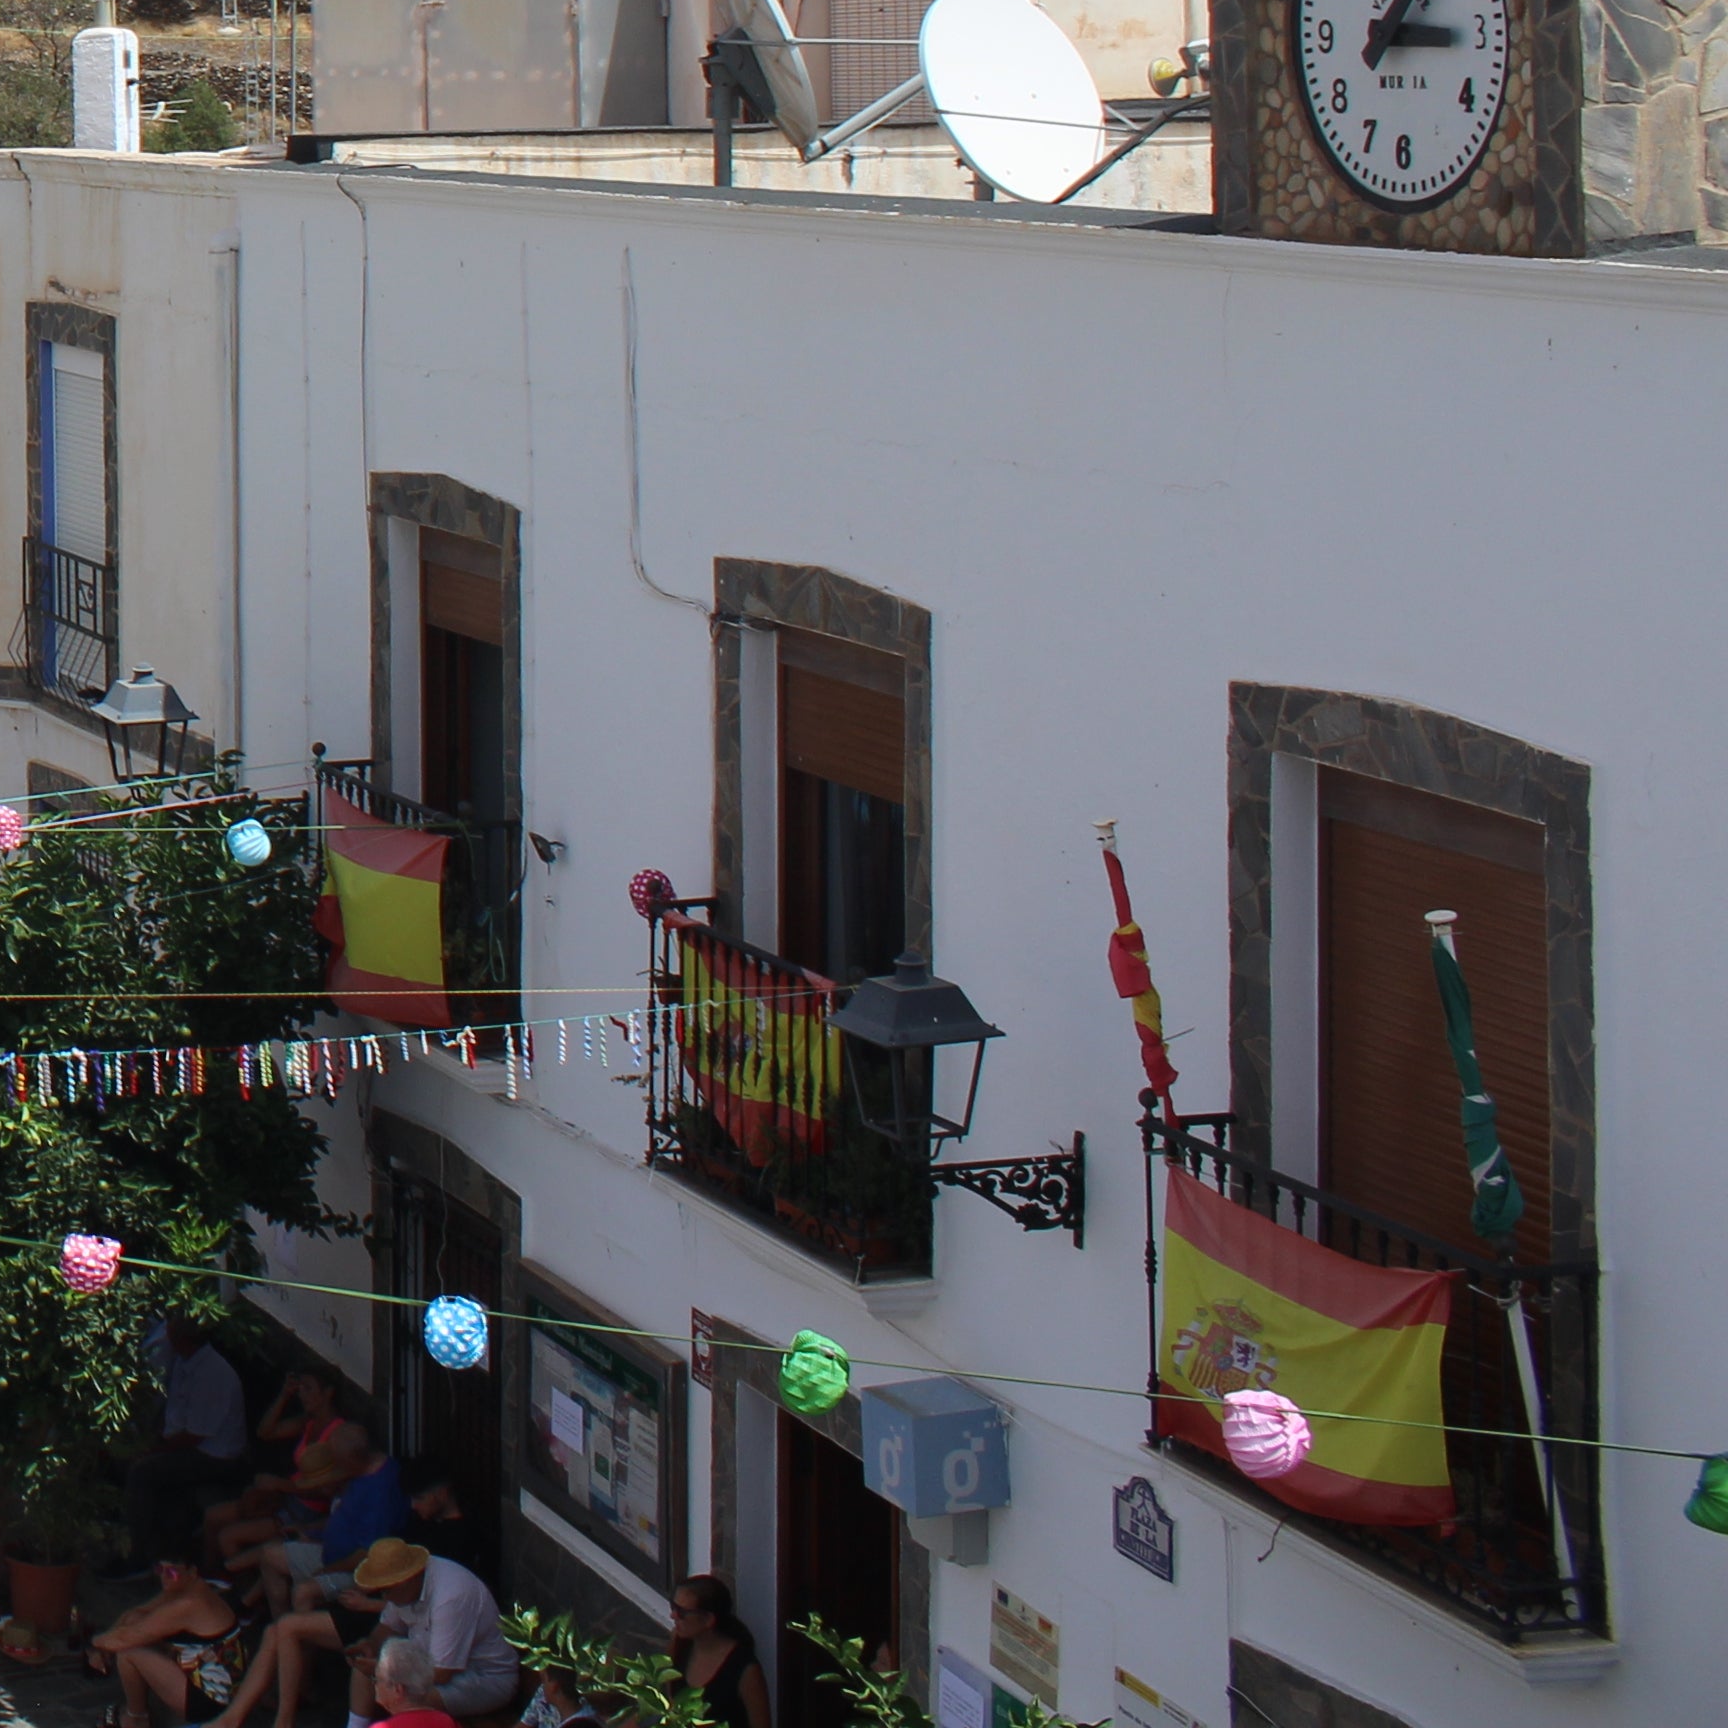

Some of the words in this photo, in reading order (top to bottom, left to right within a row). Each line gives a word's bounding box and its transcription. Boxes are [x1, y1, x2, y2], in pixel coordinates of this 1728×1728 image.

[1318, 19, 1334, 54] 9
[1474, 14, 1487, 50] 3
[1331, 78, 1348, 114] 8
[1458, 77, 1475, 113] 4
[1362, 119, 1377, 154] 7
[1395, 134, 1411, 170] 6
